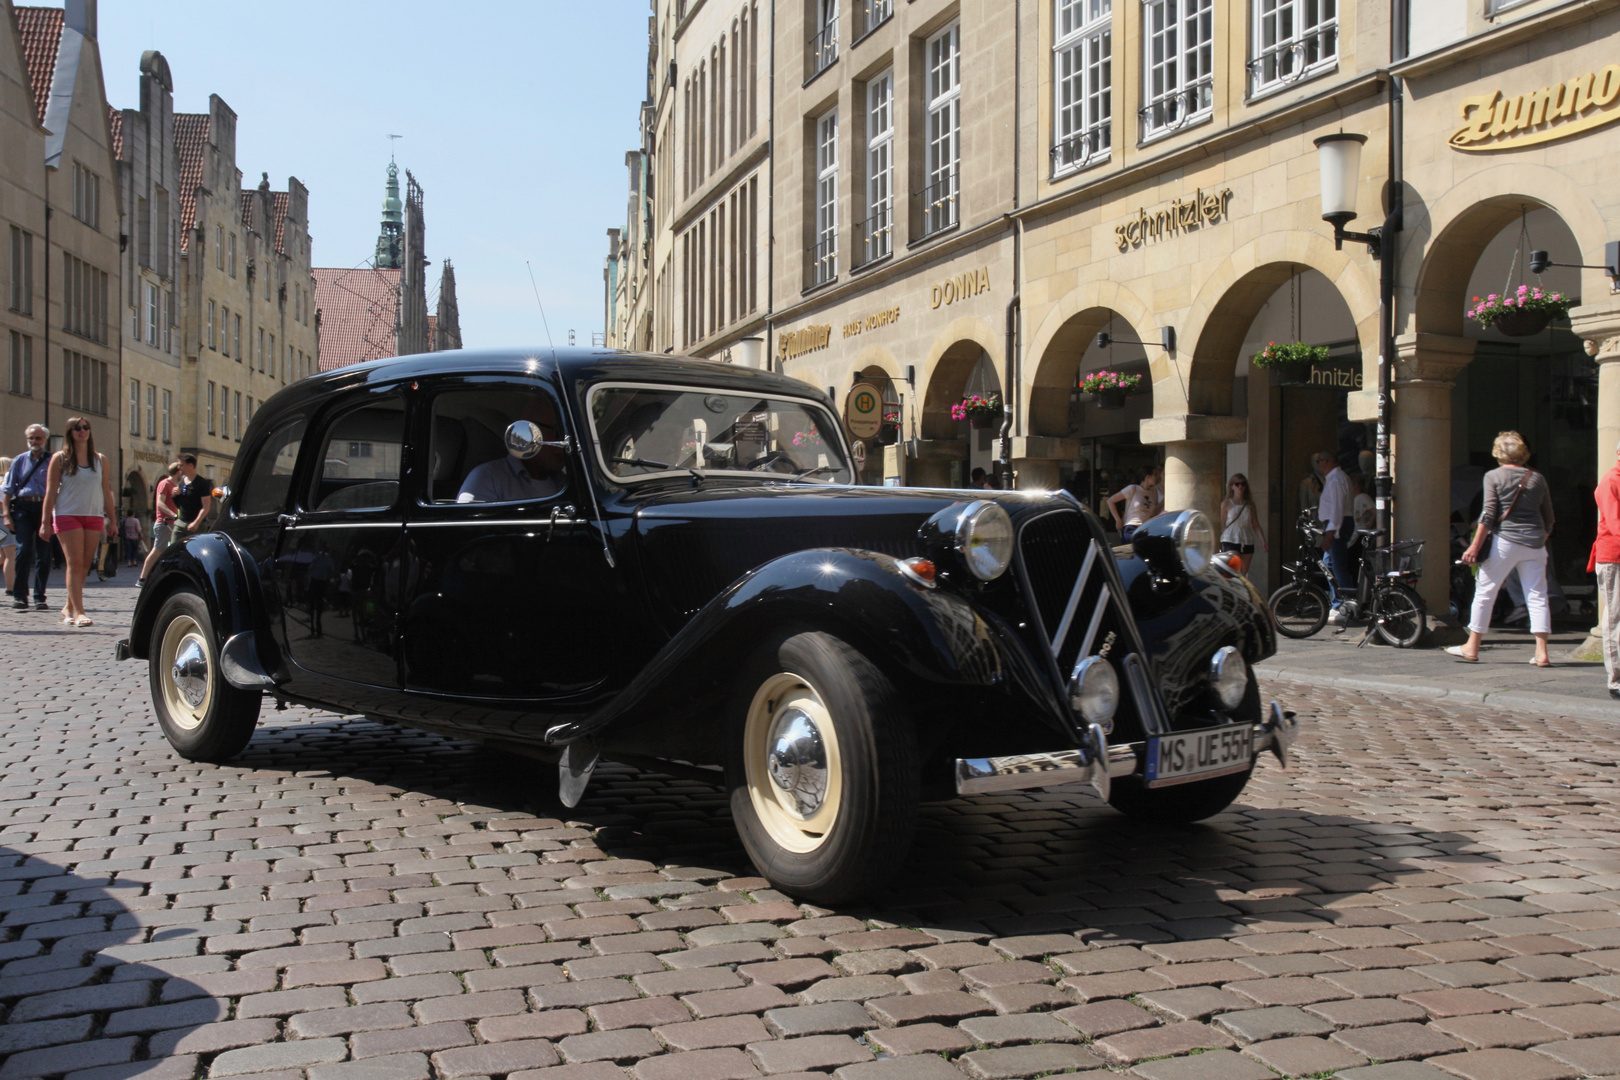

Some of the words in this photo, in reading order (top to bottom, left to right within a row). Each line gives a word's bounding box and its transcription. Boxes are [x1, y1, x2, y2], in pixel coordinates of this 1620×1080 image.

[1114, 187, 1231, 248] schnitzler
[931, 265, 990, 309] DONNA
[842, 320, 861, 339] HAUS
[860, 396, 870, 409] H
[1160, 738, 1186, 773] MS
